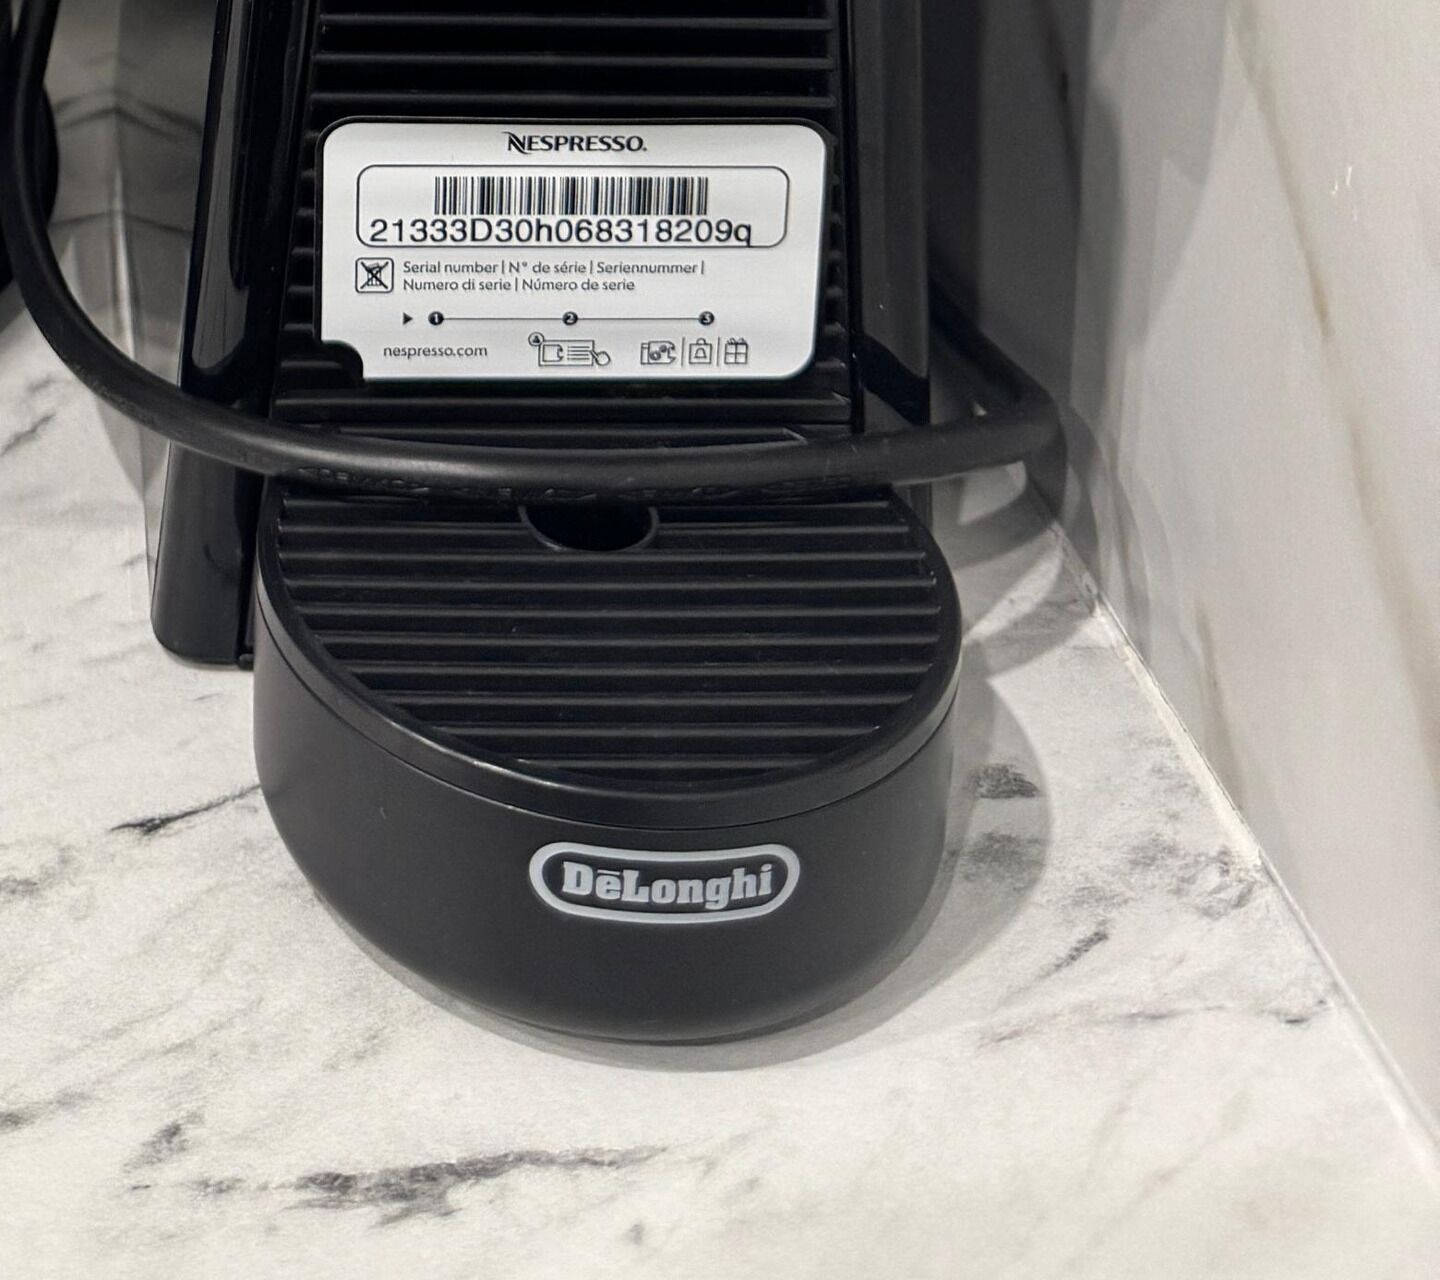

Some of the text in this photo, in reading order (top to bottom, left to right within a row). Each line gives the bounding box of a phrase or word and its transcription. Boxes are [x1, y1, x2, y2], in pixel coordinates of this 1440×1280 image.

[370, 218, 752, 247] 21333D30h068318209q
[403, 261, 440, 273] Serial
[445, 261, 498, 273] number
[533, 261, 550, 273] de
[554, 261, 586, 273] série
[597, 261, 698, 273] Seriennummer
[403, 277, 635, 290] Numero di serie Número de serie
[383, 346, 488, 359] nespresso.com
